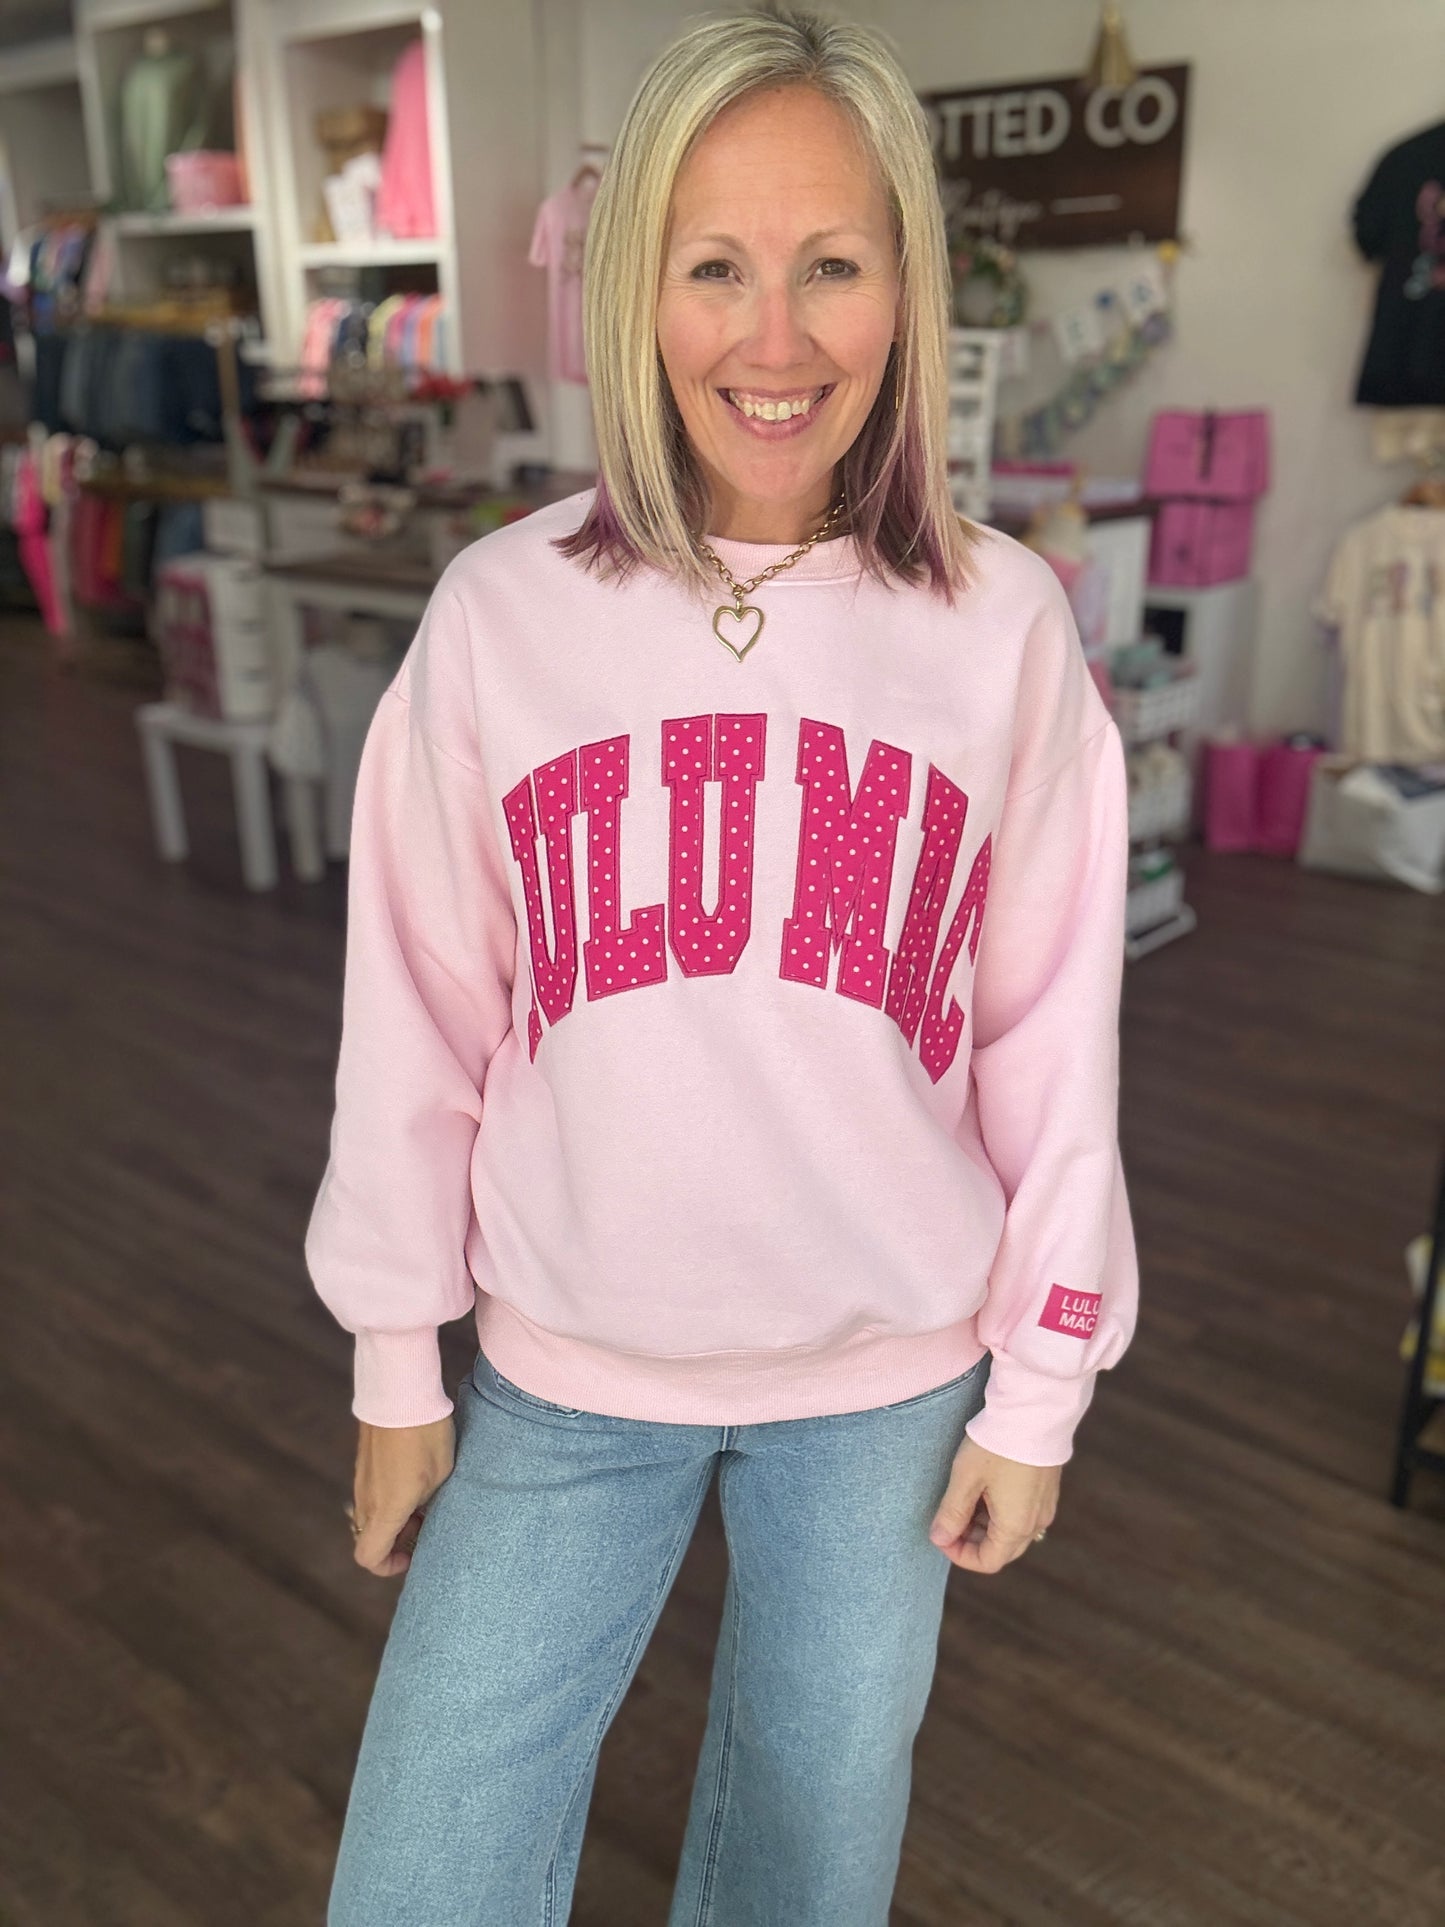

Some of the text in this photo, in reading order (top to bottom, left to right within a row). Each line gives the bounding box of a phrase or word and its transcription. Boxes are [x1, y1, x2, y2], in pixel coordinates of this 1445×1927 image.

[1085, 76, 1178, 148] CO
[502, 713, 992, 1085] ULU MAC
[1058, 1311, 1096, 1332] MAC
